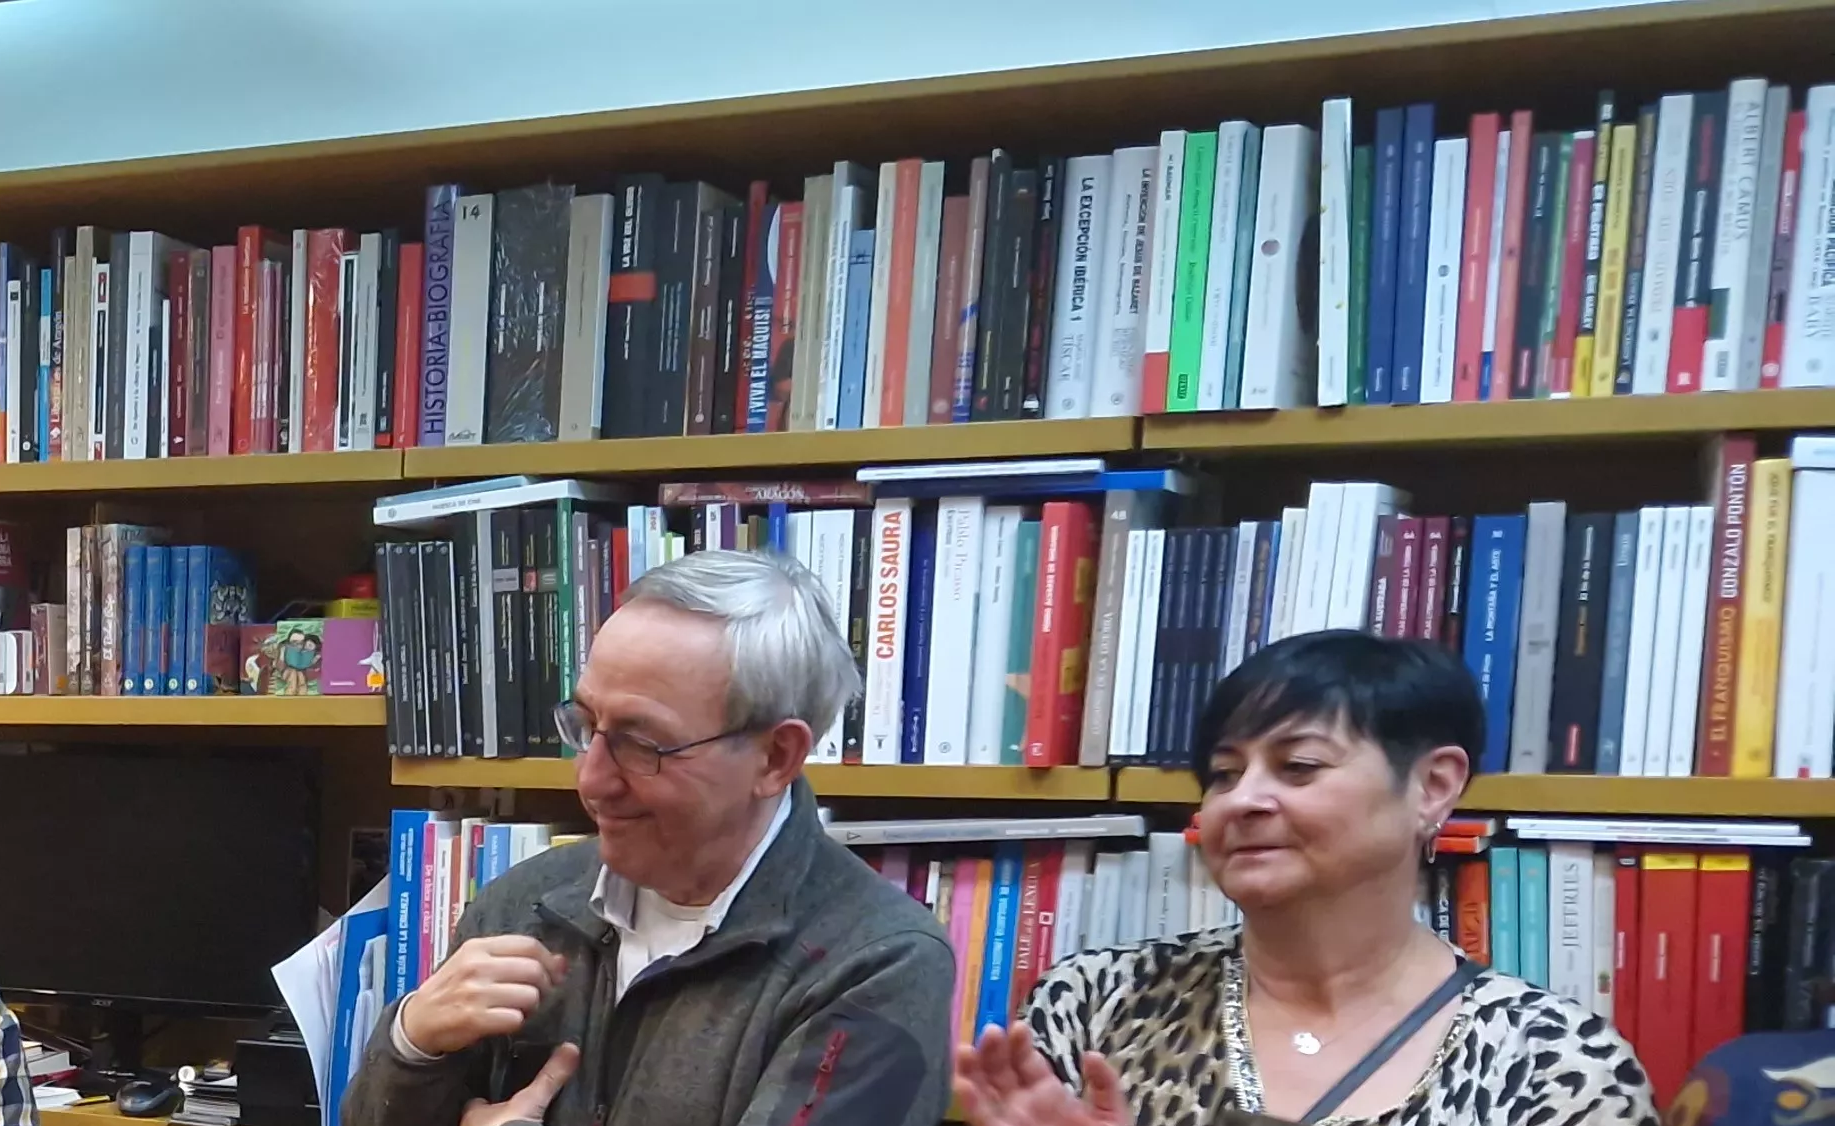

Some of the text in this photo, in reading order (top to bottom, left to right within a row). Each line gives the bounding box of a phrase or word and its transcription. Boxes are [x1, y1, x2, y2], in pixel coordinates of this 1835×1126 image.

[1082, 178, 1094, 192] LA
[1074, 196, 1093, 262] EXCEPCIÓN
[749, 309, 770, 413] ¡VIVA EL MAQUIS!
[875, 511, 902, 659] CARLOS SAURA
[1709, 463, 1747, 741] EL FRANQUISMO GONZALO PONTÓN
[399, 930, 408, 940] LA
[1562, 863, 1582, 948] JEFFRIES
[1016, 934, 1031, 969] DALE
